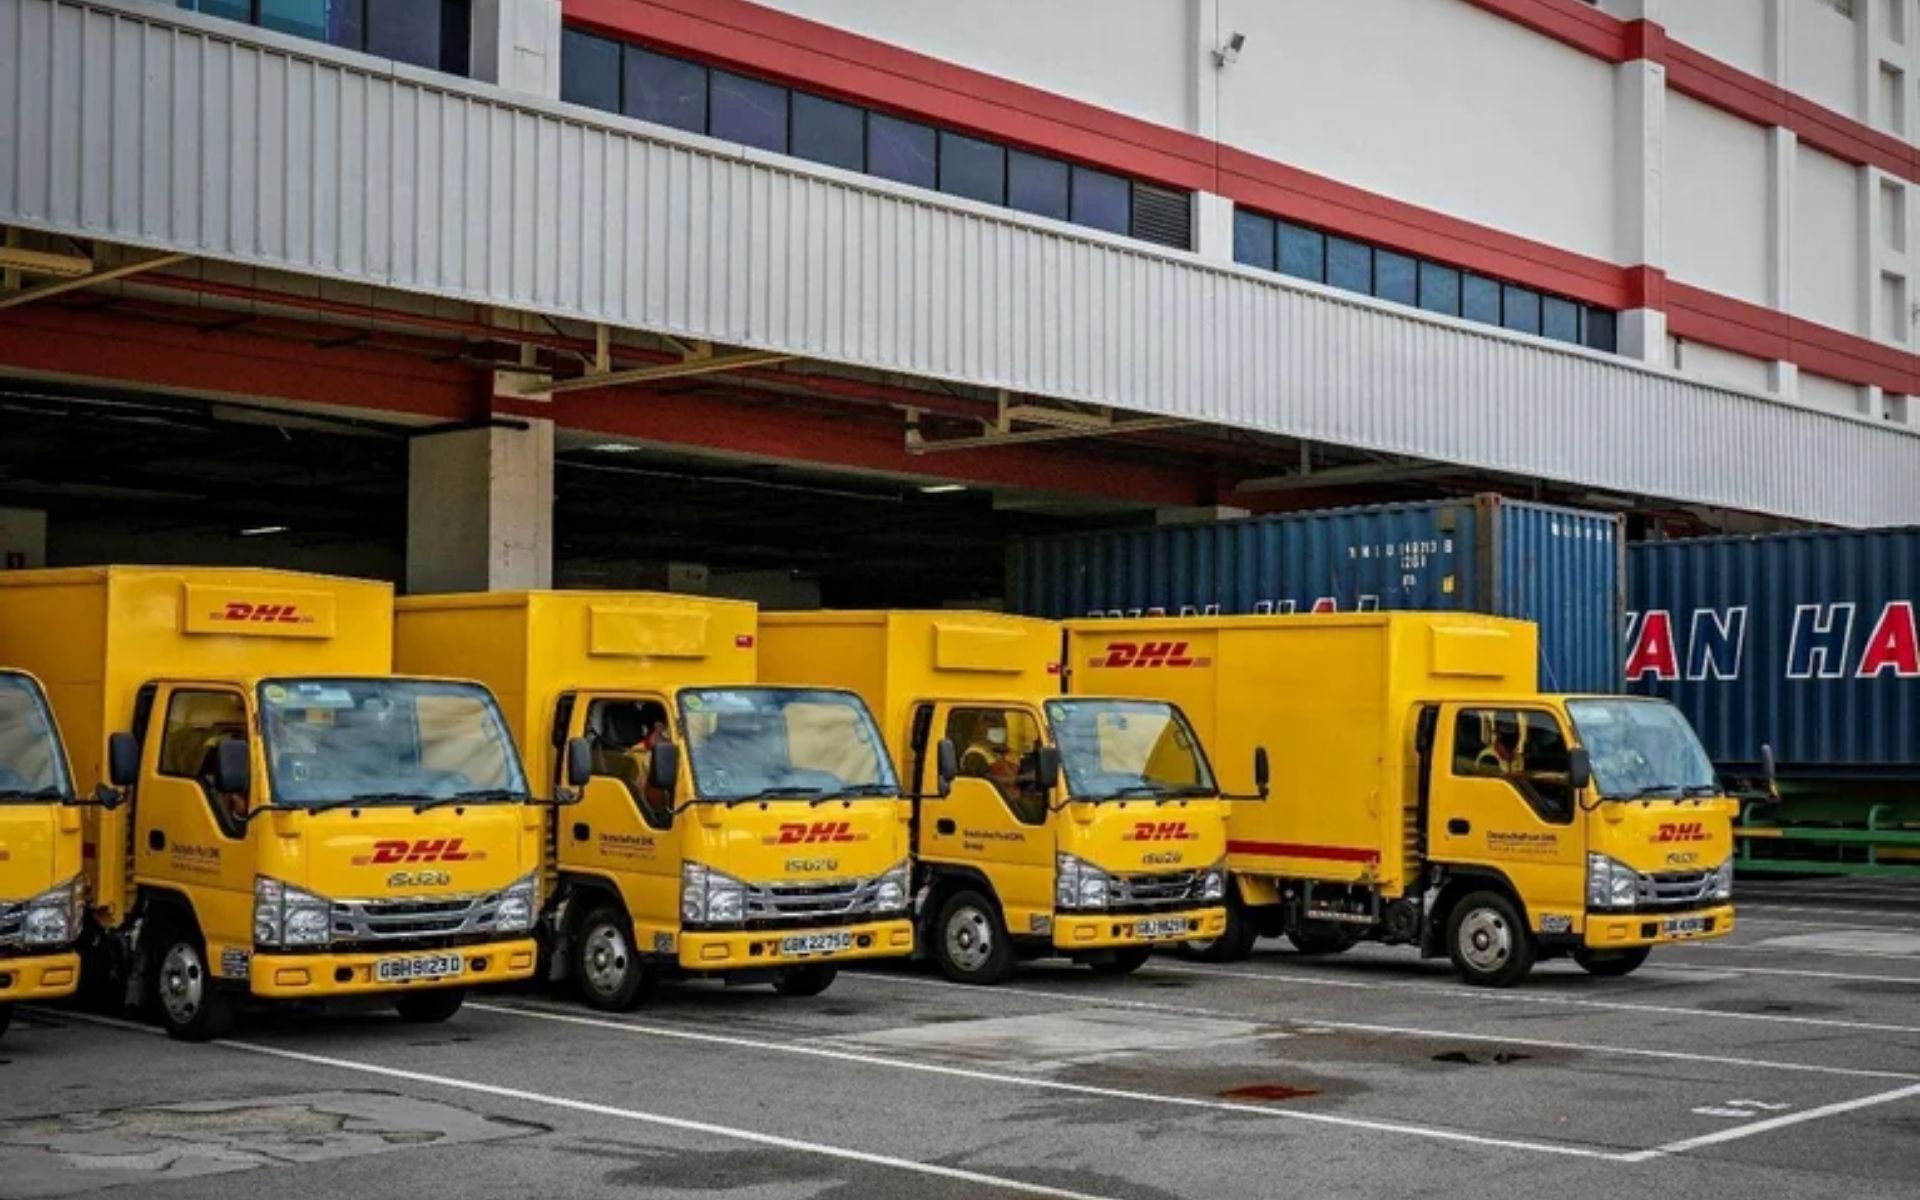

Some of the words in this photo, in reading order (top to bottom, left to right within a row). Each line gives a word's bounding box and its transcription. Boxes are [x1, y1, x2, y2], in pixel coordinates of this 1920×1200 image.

[224, 602, 300, 623] DHL
[1105, 642, 1193, 668] DHL
[779, 821, 855, 844] DHL
[1134, 821, 1190, 841] DHL
[1658, 822, 1705, 842] DHL
[371, 837, 470, 864] DHL
[386, 871, 450, 888] ISUZU
